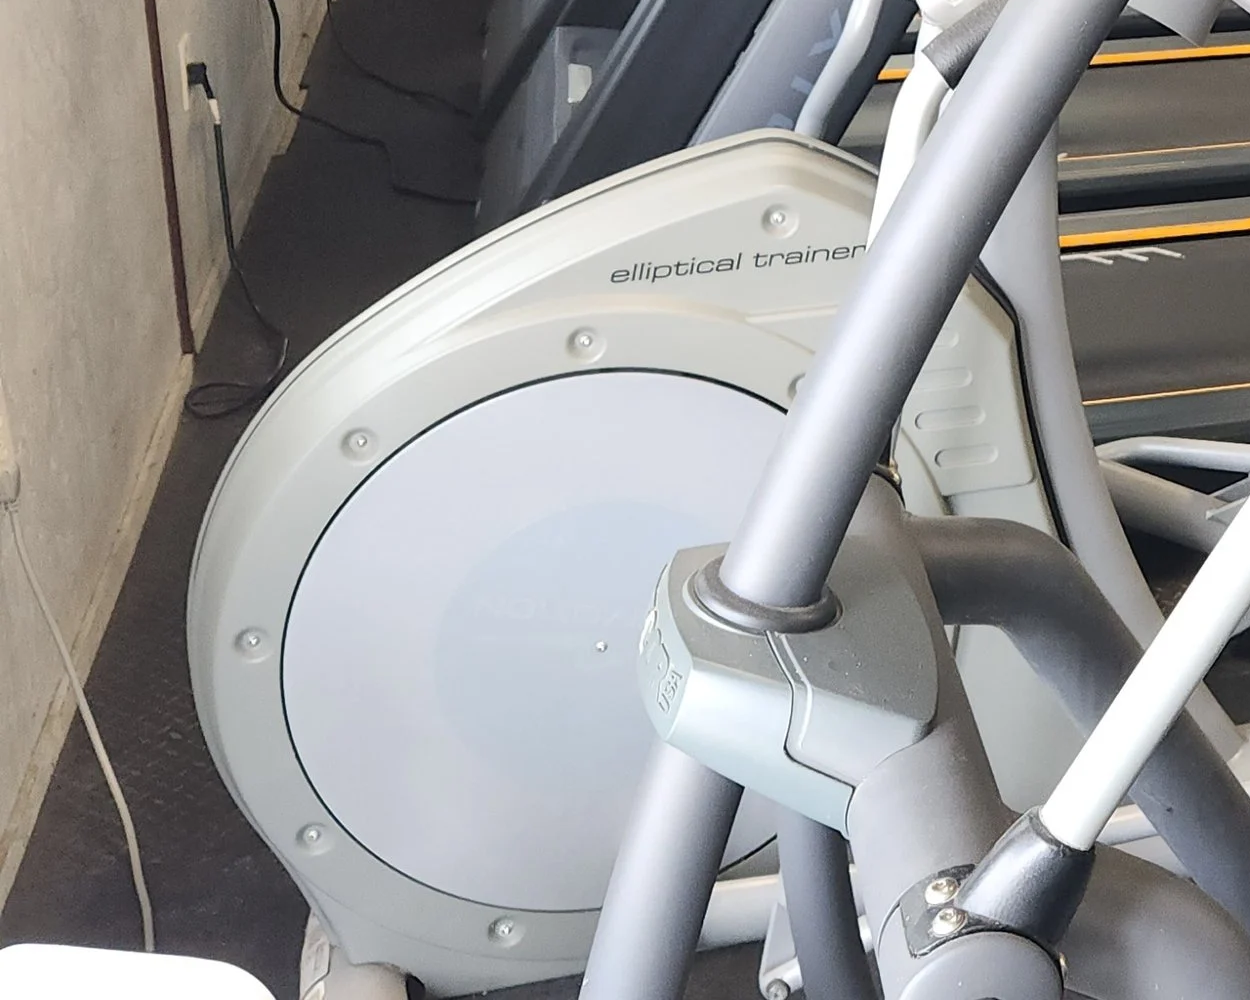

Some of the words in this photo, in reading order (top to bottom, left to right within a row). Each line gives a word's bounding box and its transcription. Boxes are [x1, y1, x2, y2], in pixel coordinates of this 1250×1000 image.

[610, 252, 743, 284] elliptical
[753, 244, 867, 269] trainer
[658, 668, 683, 715] USA
